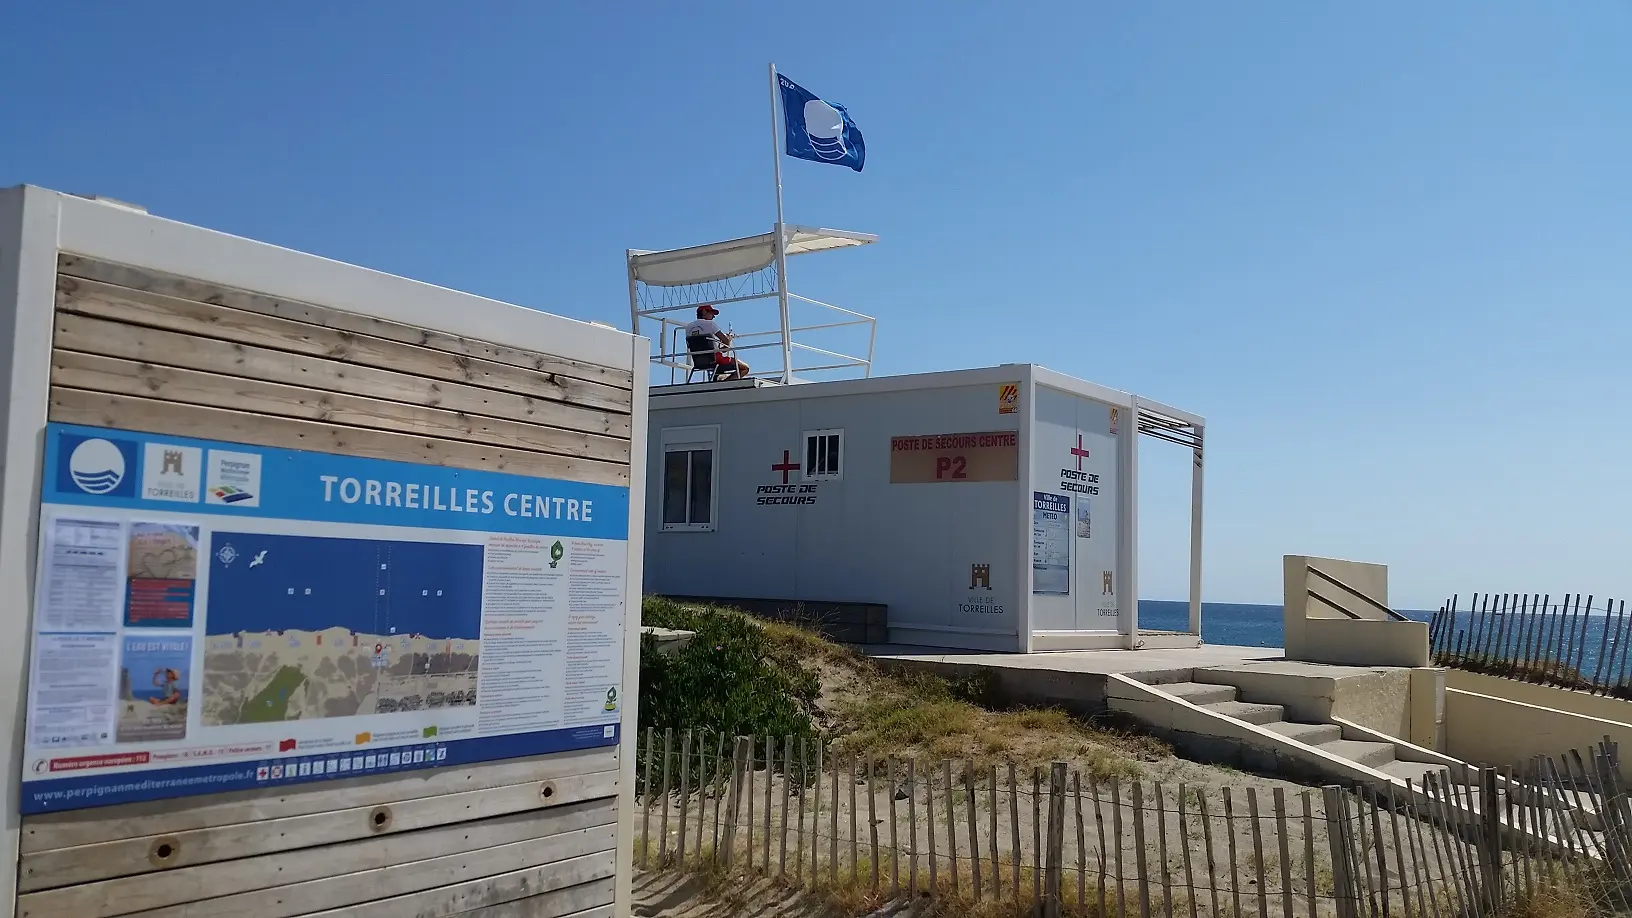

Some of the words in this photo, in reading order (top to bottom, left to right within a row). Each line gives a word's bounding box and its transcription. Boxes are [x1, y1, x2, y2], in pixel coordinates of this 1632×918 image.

[892, 438, 919, 451] POSTE
[921, 438, 933, 449] DE
[935, 436, 977, 449] SECOURS
[979, 434, 1016, 448] CENTRE
[936, 456, 967, 479] P2
[1060, 469, 1087, 481] POSTE
[1088, 473, 1099, 483] DE
[147, 487, 195, 499] TORREILLES
[756, 485, 797, 494] POSTE
[799, 485, 818, 493] DE
[1060, 481, 1099, 495] SECOURS
[320, 475, 494, 514] TORREILLES
[503, 493, 593, 522] CENTRE
[756, 496, 817, 505] SECOURS
[1034, 500, 1067, 512] TORREILLES
[958, 604, 1004, 614] TORREILLES
[33, 770, 254, 803] www.perpignanmediterraneemetropole.fr
